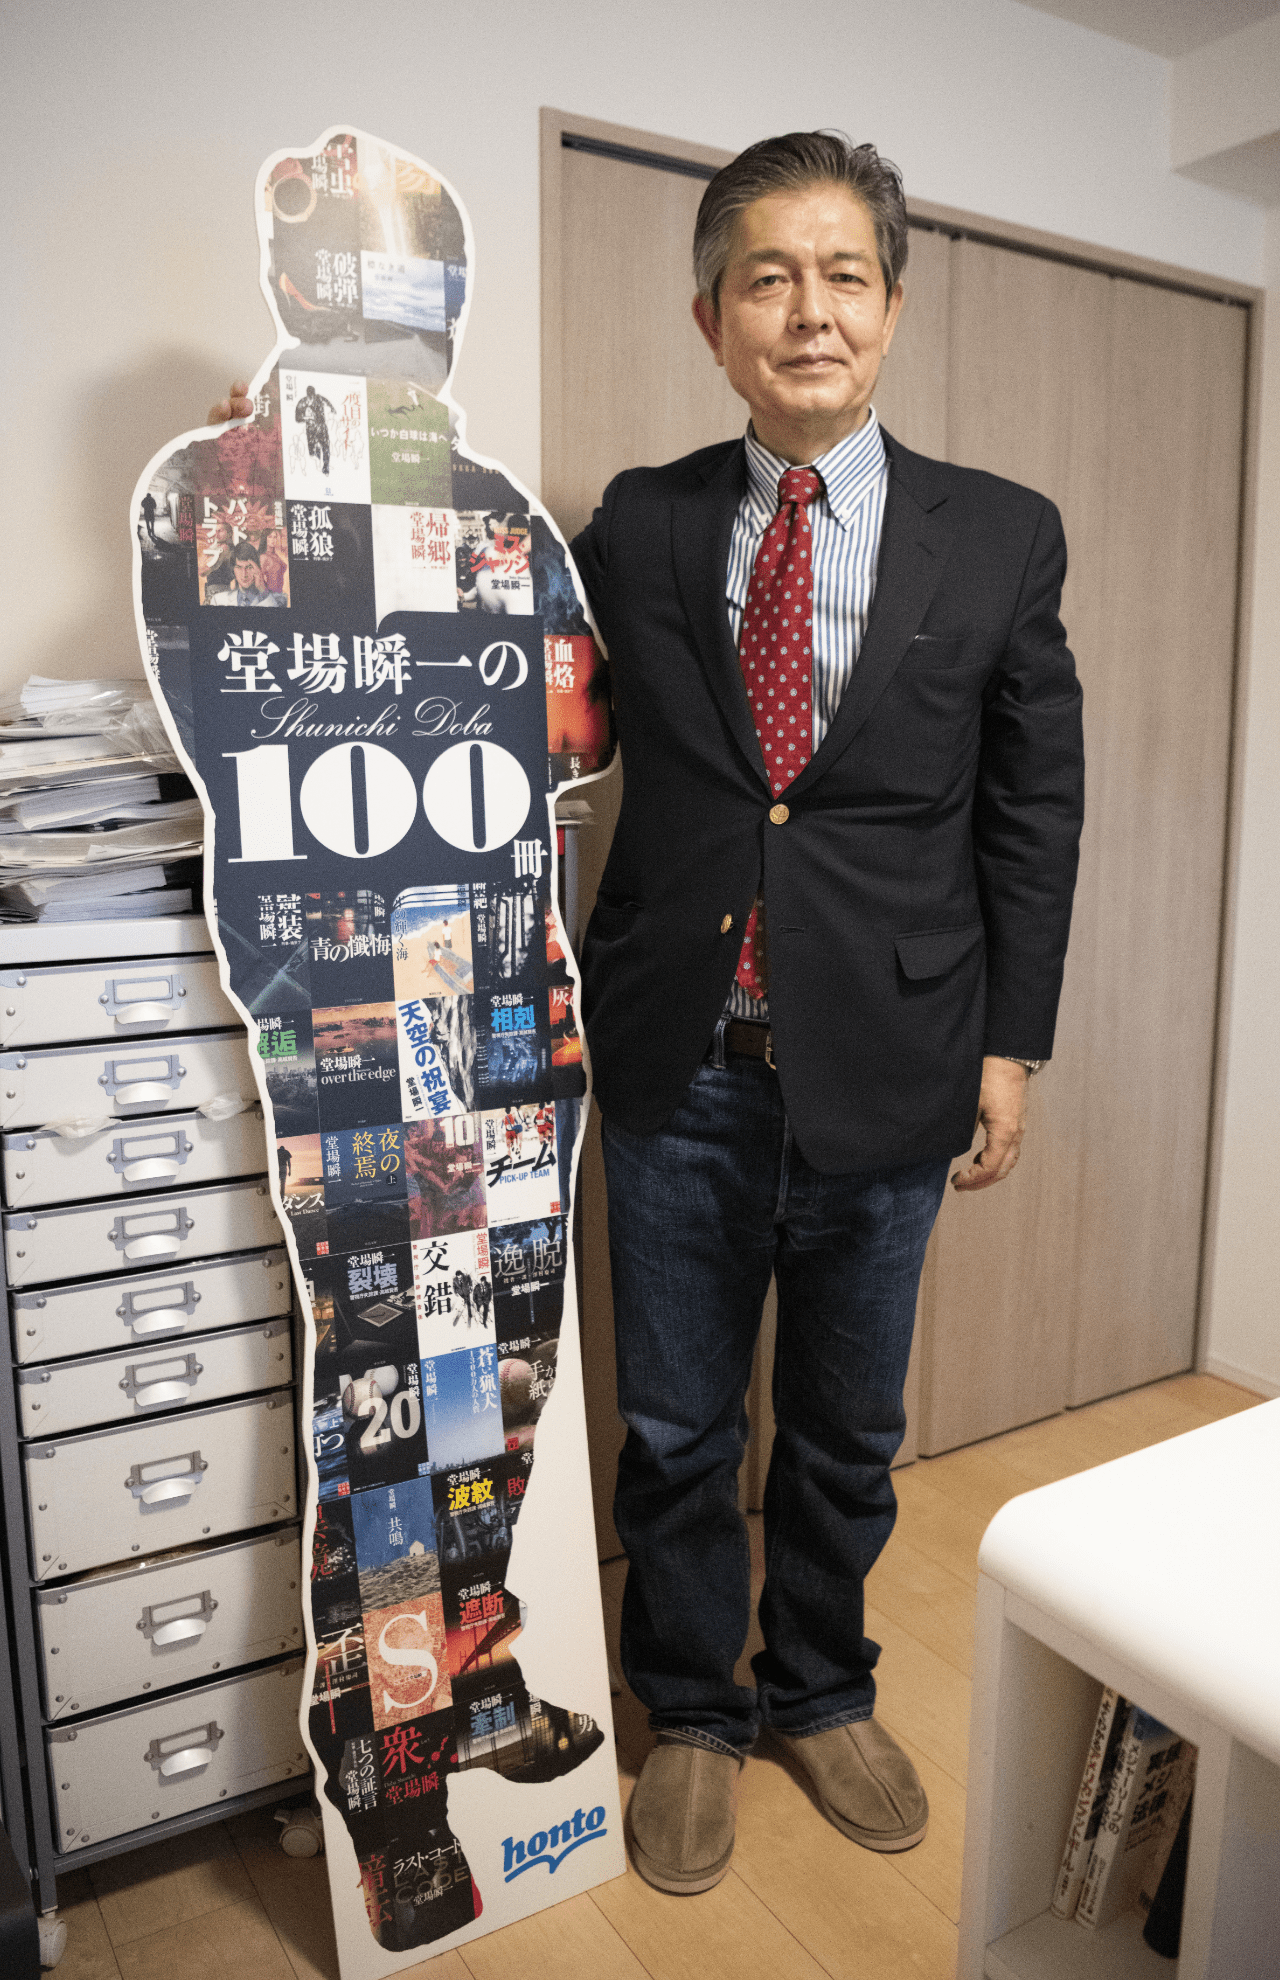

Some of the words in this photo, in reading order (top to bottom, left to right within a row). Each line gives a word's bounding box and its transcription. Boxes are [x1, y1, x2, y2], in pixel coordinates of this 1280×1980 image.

[334, 251, 360, 304] 破弾
[370, 427, 449, 445] いつか白球は海へ
[202, 497, 224, 568] トラップ
[227, 498, 249, 546] バッド
[308, 505, 335, 557] 孤狼
[426, 512, 451, 565] 帰郷
[469, 552, 530, 574] ジャッジ
[491, 579, 531, 590] 堂場瞬一
[217, 629, 529, 696] 堂場瞬一の
[554, 639, 575, 688] 血烙
[250, 696, 402, 740] Shunichi
[411, 696, 494, 738] Doba
[221, 739, 532, 864] 100
[511, 838, 549, 880] 冊
[310, 932, 392, 963] 青の懺悔
[491, 1004, 536, 1032] 相剋
[320, 1054, 376, 1073] 堂場瞬一
[321, 1073, 350, 1086] over
[350, 1066, 368, 1082] the
[368, 1065, 397, 1083] edge
[398, 1000, 452, 1116] 天空の祝宴
[378, 1128, 400, 1173] 夜の
[440, 1114, 475, 1149] 10
[325, 1136, 342, 1184] 堂場瞬一
[351, 1130, 376, 1179] 終焉
[486, 1143, 557, 1188] チーム
[499, 1172, 529, 1184] PICK-UP
[530, 1168, 550, 1179] TEAM
[347, 1262, 399, 1294] 裂壊
[420, 1240, 453, 1318] 交錯
[494, 1234, 563, 1279] 逸脱
[529, 1359, 548, 1401] 手紙
[357, 1390, 421, 1449] 20
[447, 1478, 495, 1511] 波紋
[388, 1516, 404, 1546] 共鳴
[458, 1590, 505, 1625] 遮断
[378, 1610, 438, 1714] S
[470, 1700, 516, 1738] 牽制
[379, 1726, 425, 1777] 衆
[357, 1739, 378, 1810] 七つの証言
[501, 1806, 606, 1872] honto
